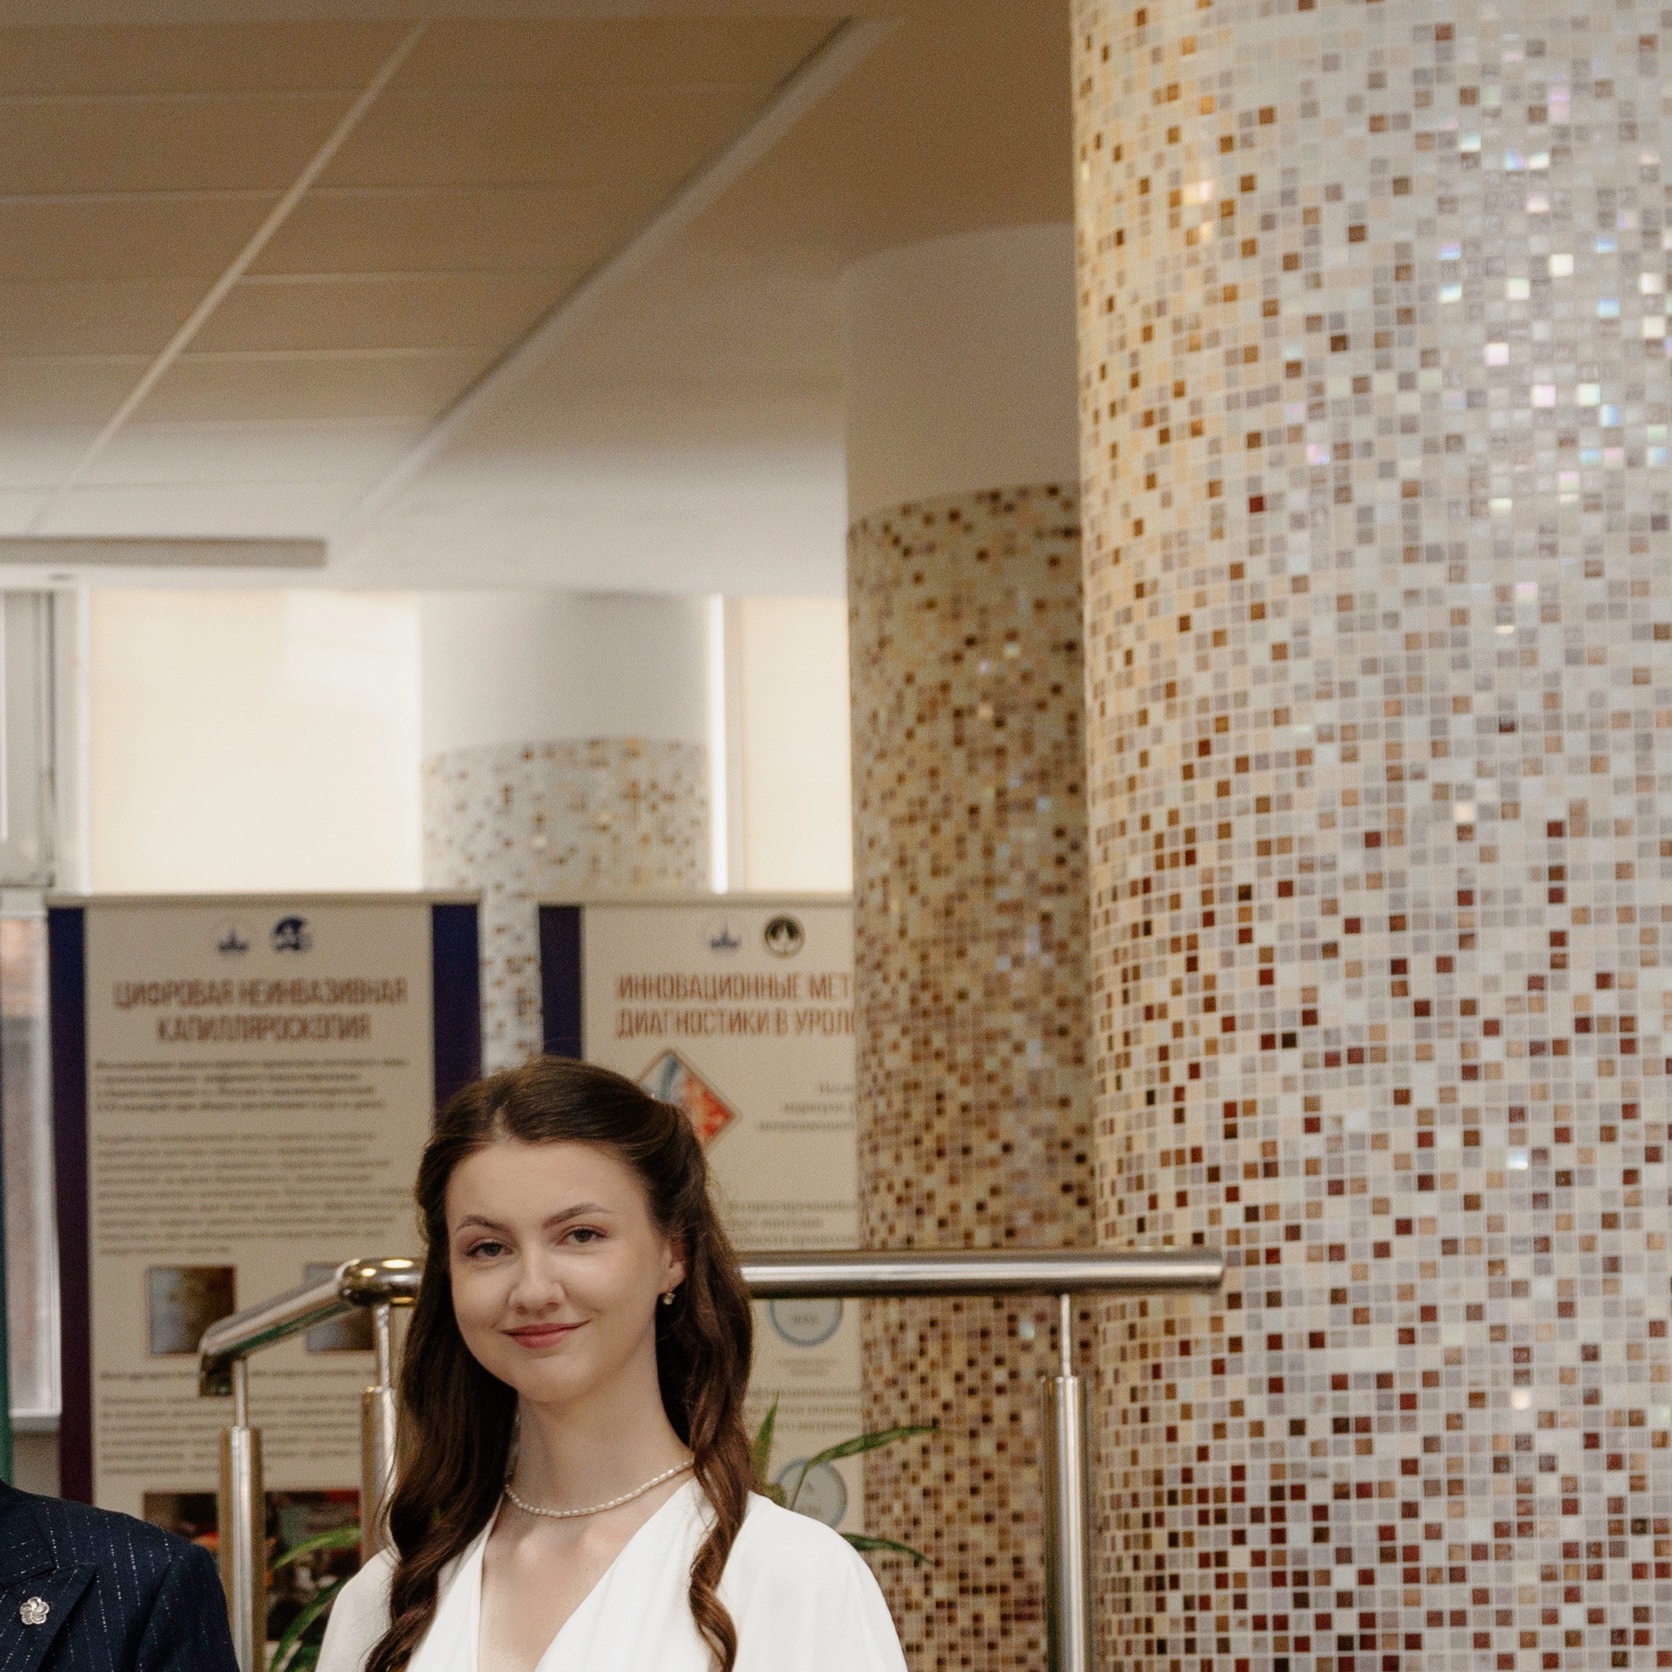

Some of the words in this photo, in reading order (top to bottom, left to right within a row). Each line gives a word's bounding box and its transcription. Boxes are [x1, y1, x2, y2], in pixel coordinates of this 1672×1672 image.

[114, 980, 234, 1012] ЦИФРОВАЯ
[238, 977, 409, 1007] НЕИНВАЗИВНАЯ
[617, 973, 801, 1002] ИННОВАЦИОННЫЕ
[156, 1014, 372, 1044] КАПИЛЛЯРОСКОПИЯ
[616, 1008, 769, 1039] ДИАГНОСТИКИ
[775, 1007, 790, 1036] В
